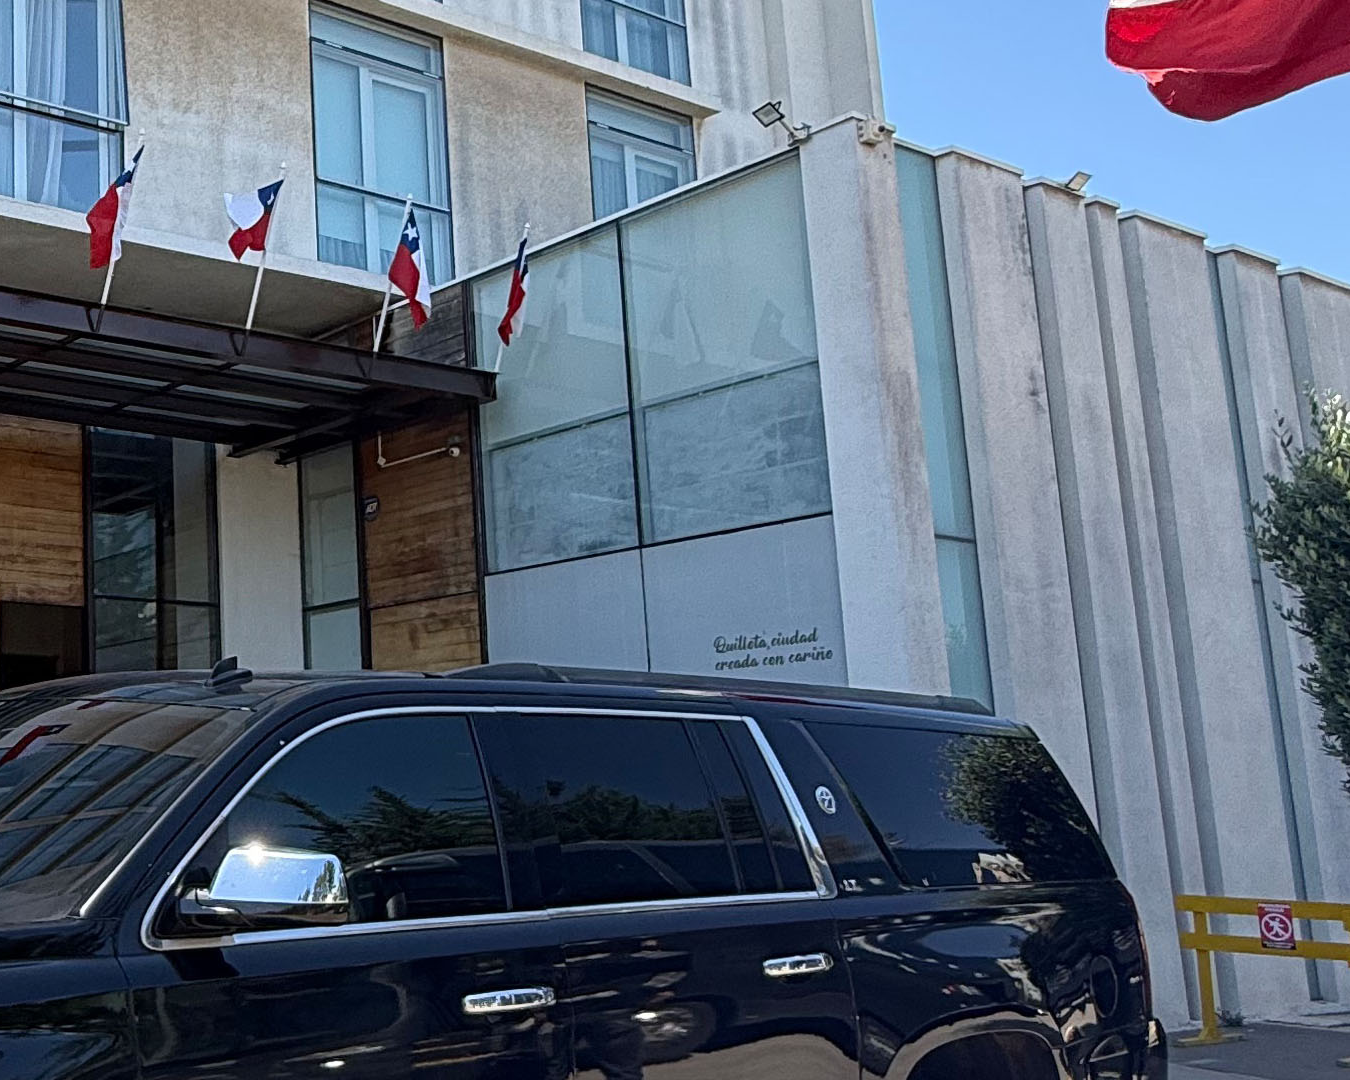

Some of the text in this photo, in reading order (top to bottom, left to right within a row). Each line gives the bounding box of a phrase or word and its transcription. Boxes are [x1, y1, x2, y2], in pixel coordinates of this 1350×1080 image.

[771, 626, 818, 646] ciudad
[715, 646, 833, 670] creada con cariño
